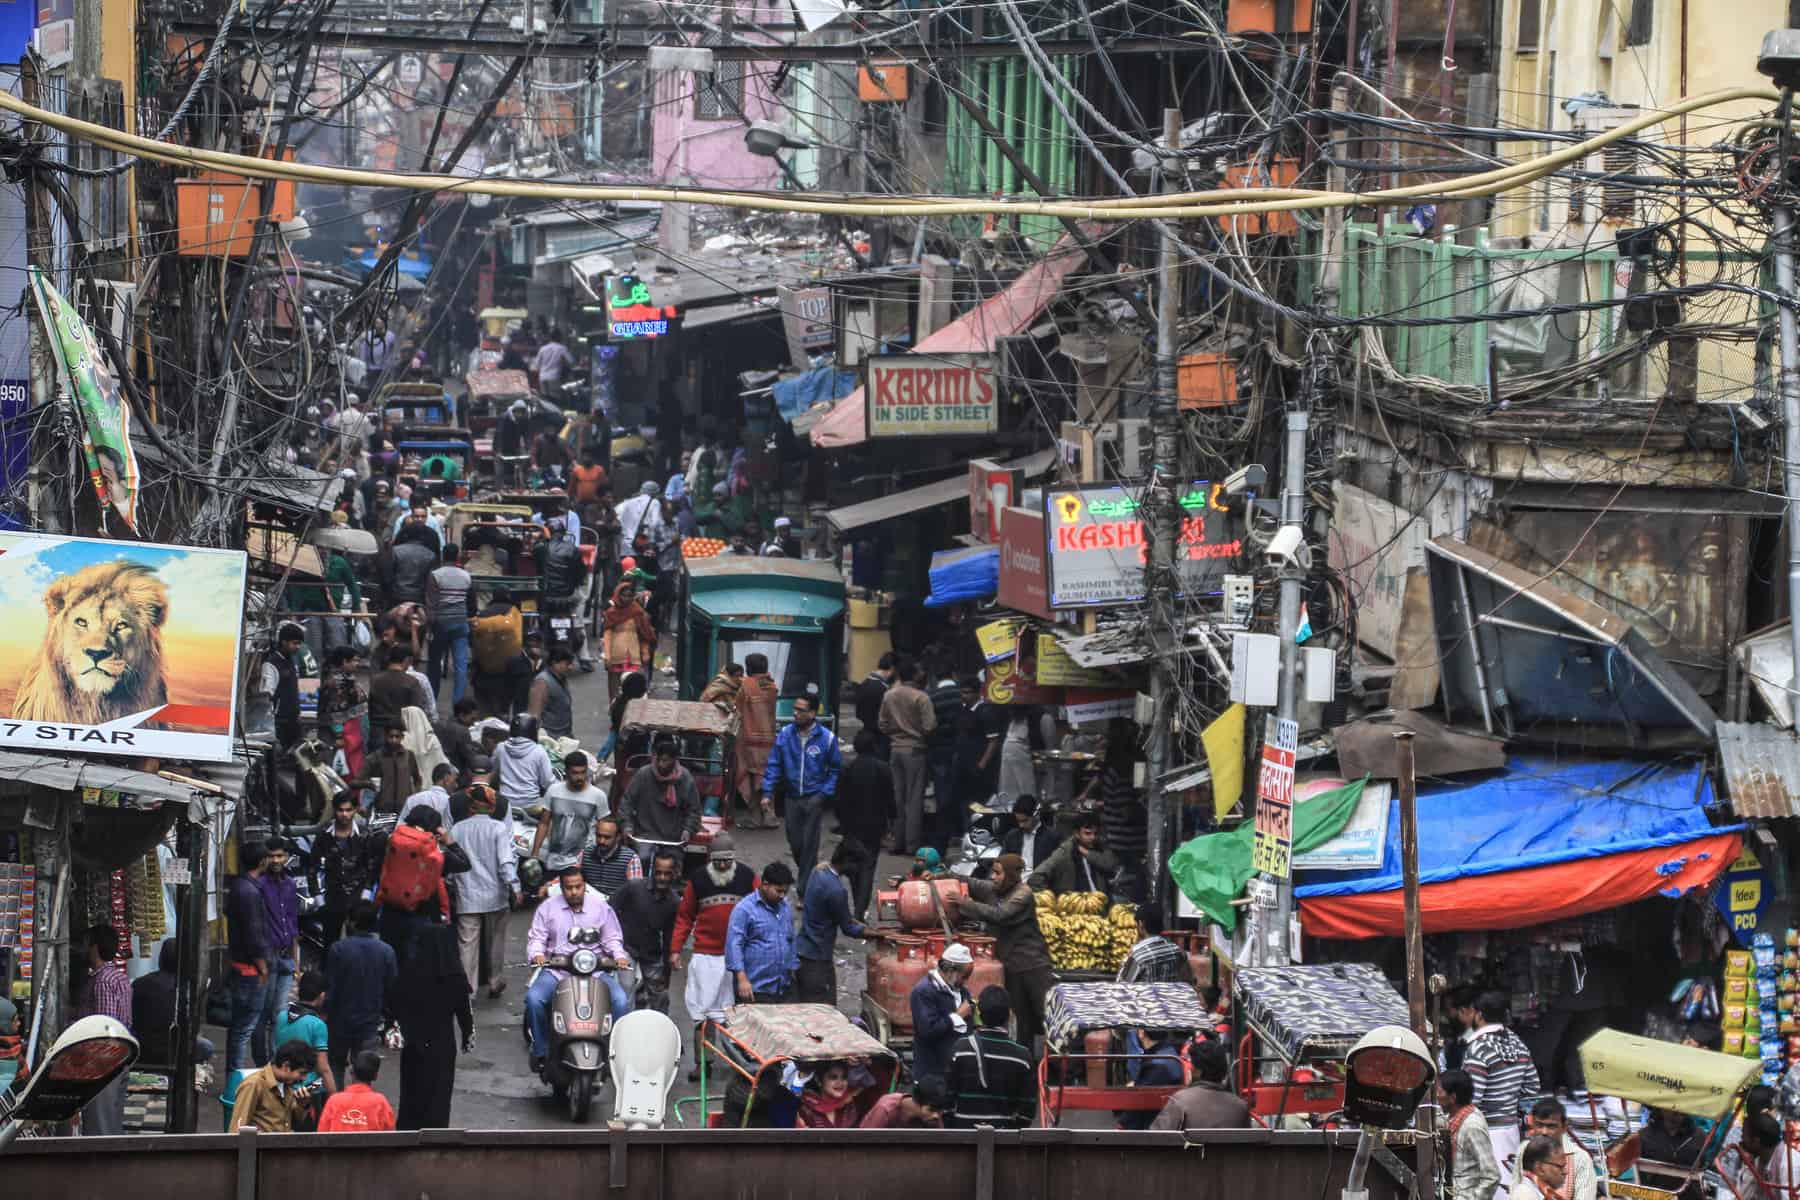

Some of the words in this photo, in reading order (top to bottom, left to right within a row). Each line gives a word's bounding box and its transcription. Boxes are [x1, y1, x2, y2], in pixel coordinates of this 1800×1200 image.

[875, 407, 890, 422] IN
[896, 405, 929, 422] SIDE
[934, 404, 992, 420] STREET
[3, 723, 23, 737] 7
[35, 725, 136, 746] STAR
[1735, 912, 1757, 930] PCO
